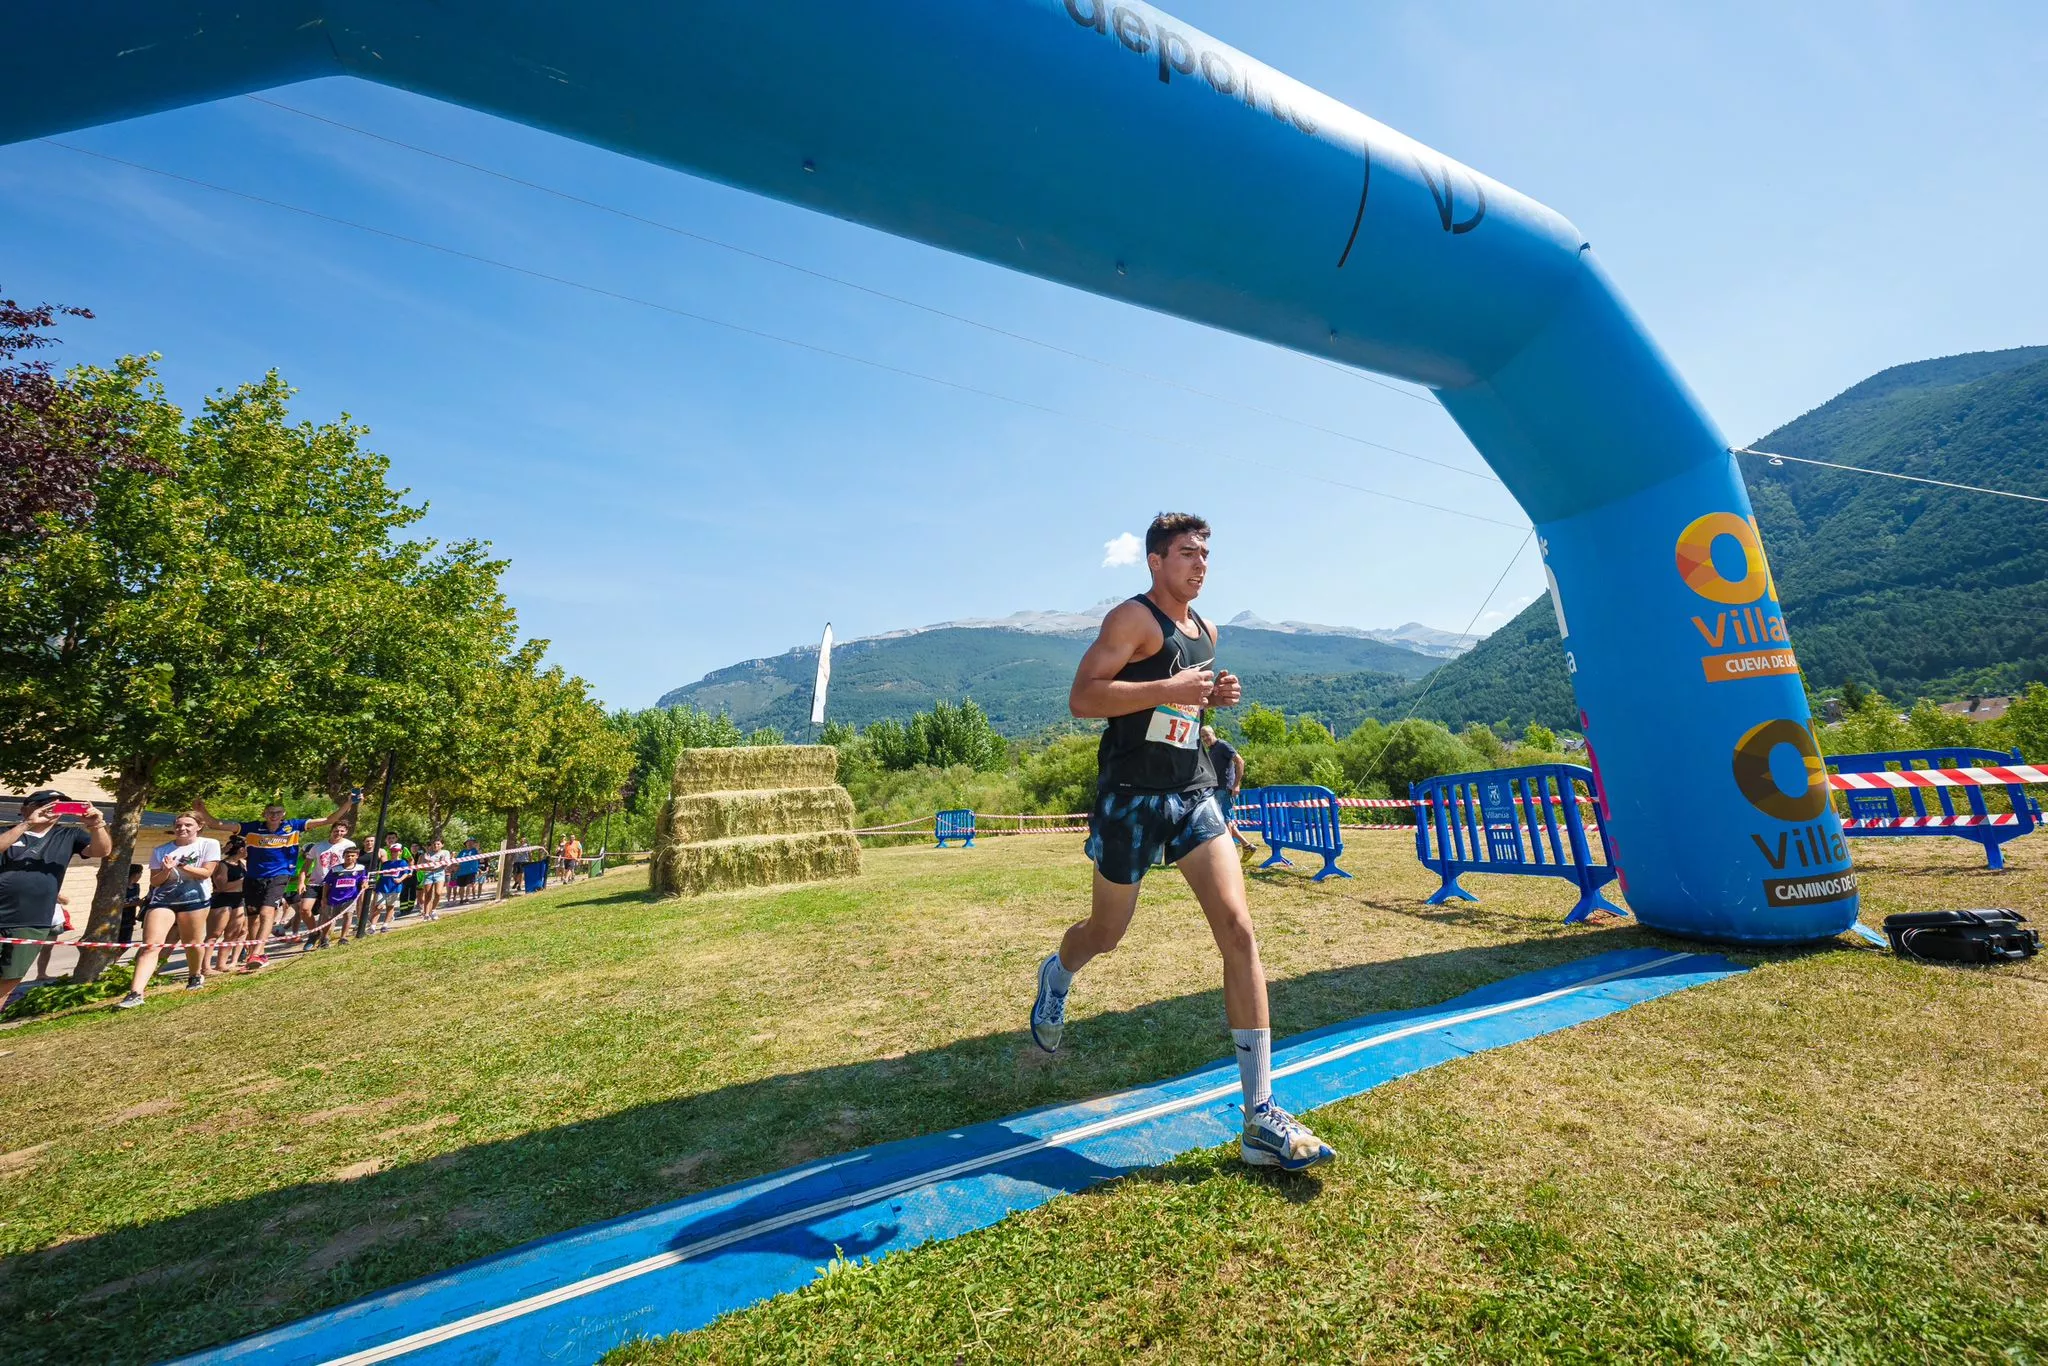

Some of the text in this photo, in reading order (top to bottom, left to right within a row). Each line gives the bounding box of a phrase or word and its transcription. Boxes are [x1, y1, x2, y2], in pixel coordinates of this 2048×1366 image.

[1725, 656, 1771, 673] CUEVA
[1771, 655, 1785, 668] DE
[1165, 719, 1190, 743] 17
[1774, 879, 1841, 900] CAMINOS
[1840, 875, 1852, 892] DE
